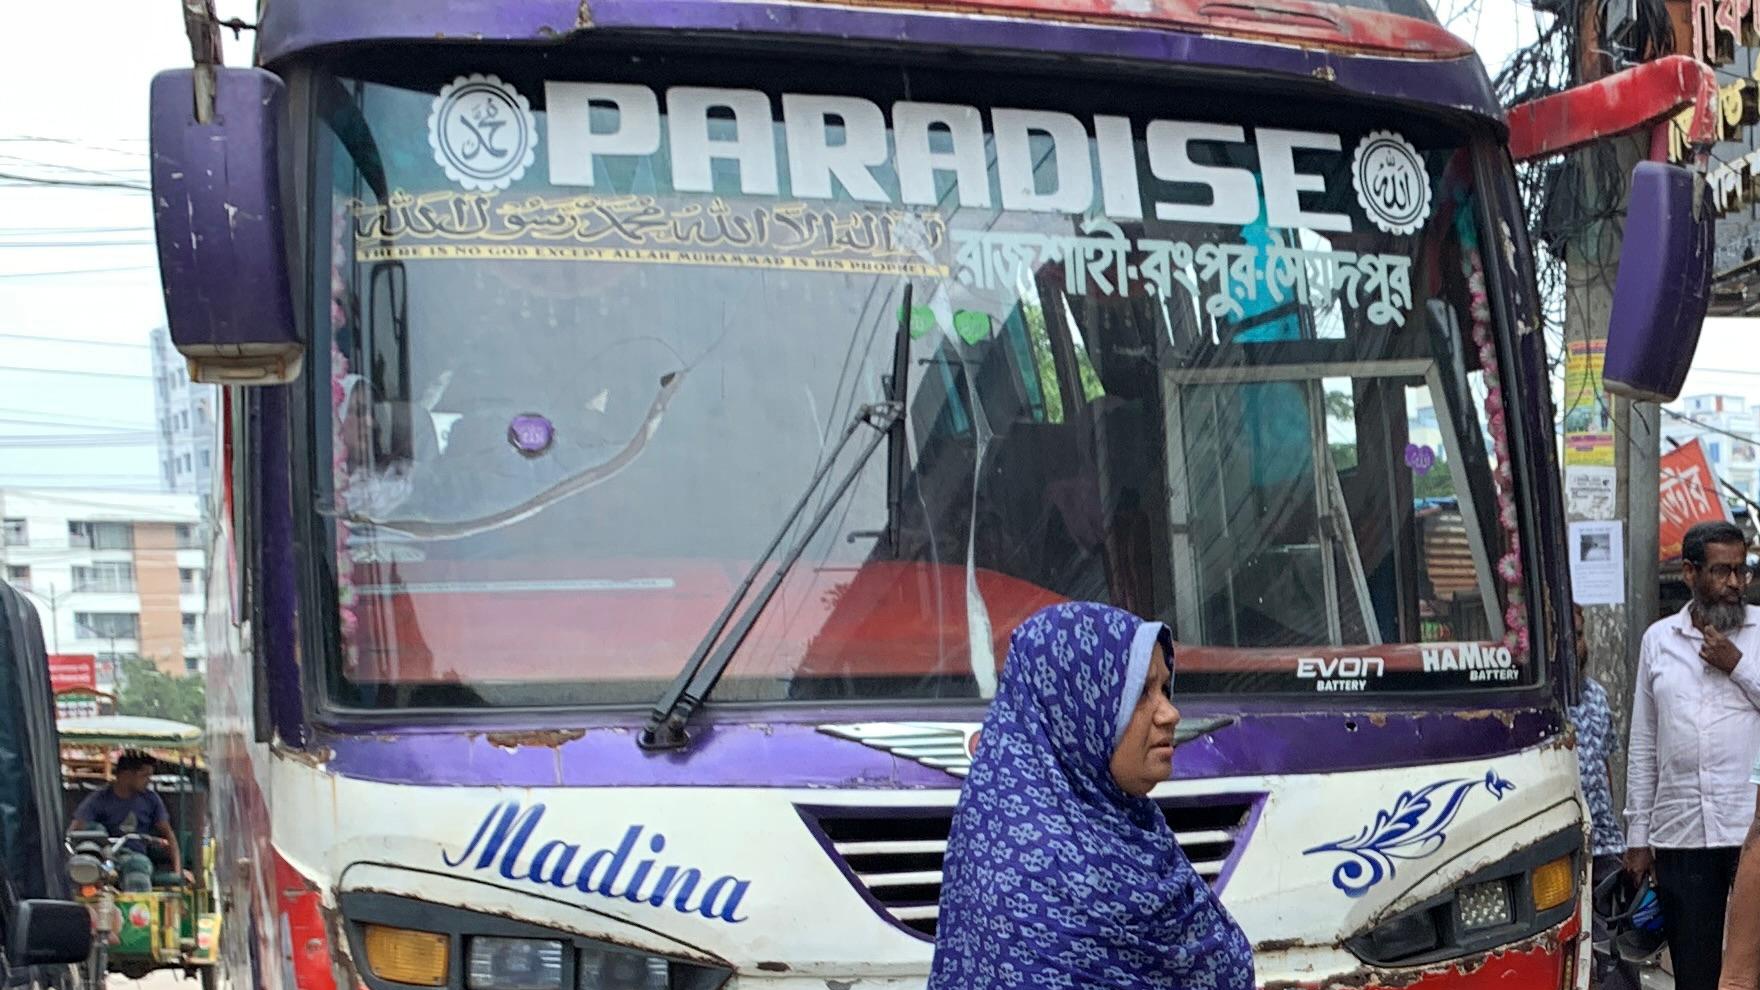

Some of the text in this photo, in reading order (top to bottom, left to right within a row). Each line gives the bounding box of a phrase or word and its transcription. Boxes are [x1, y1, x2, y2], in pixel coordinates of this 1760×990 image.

[544, 81, 1352, 233] PARADISE
[1317, 679, 1367, 692] BATTERY
[1470, 668, 1519, 682] BATTERY
[442, 800, 753, 924] Madina
